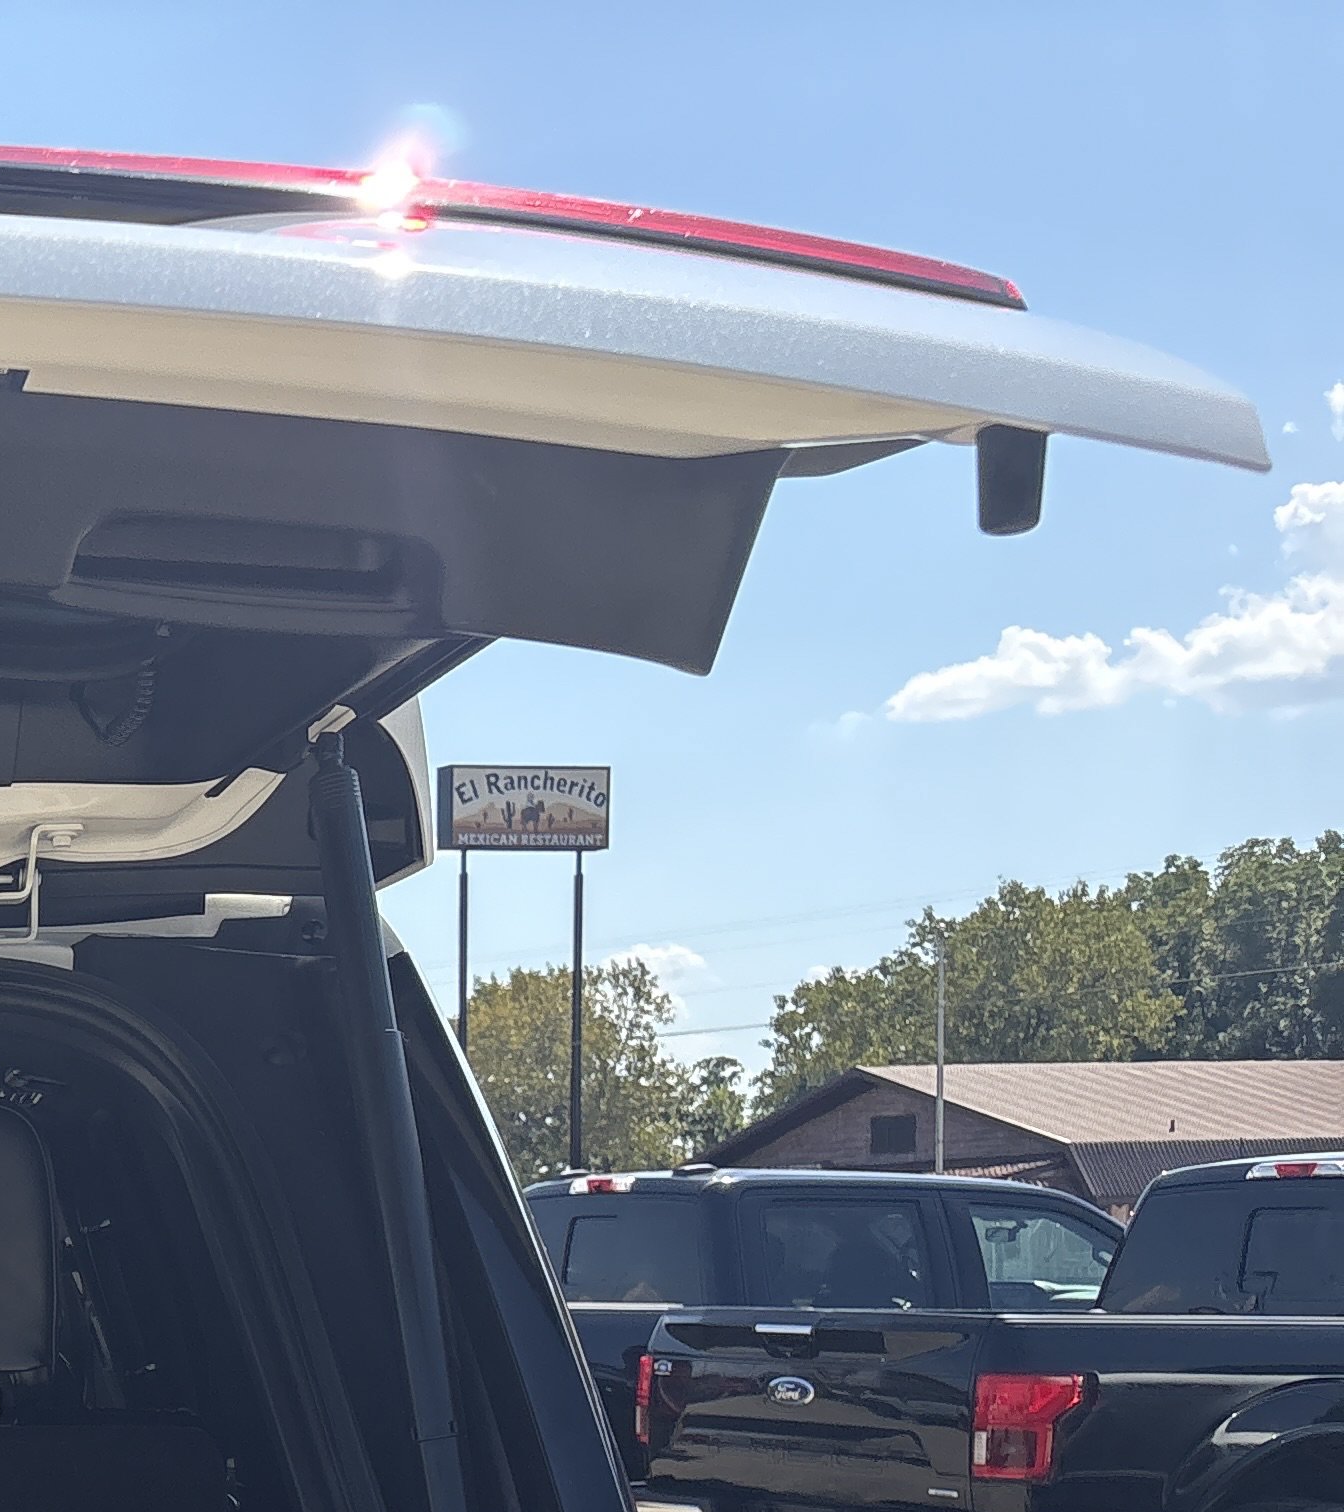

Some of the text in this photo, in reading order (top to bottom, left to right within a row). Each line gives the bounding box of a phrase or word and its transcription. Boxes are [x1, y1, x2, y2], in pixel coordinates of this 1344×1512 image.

[455, 770, 606, 808] El Rancherito
[458, 833, 603, 846] MEXICAN RESTAURANT
